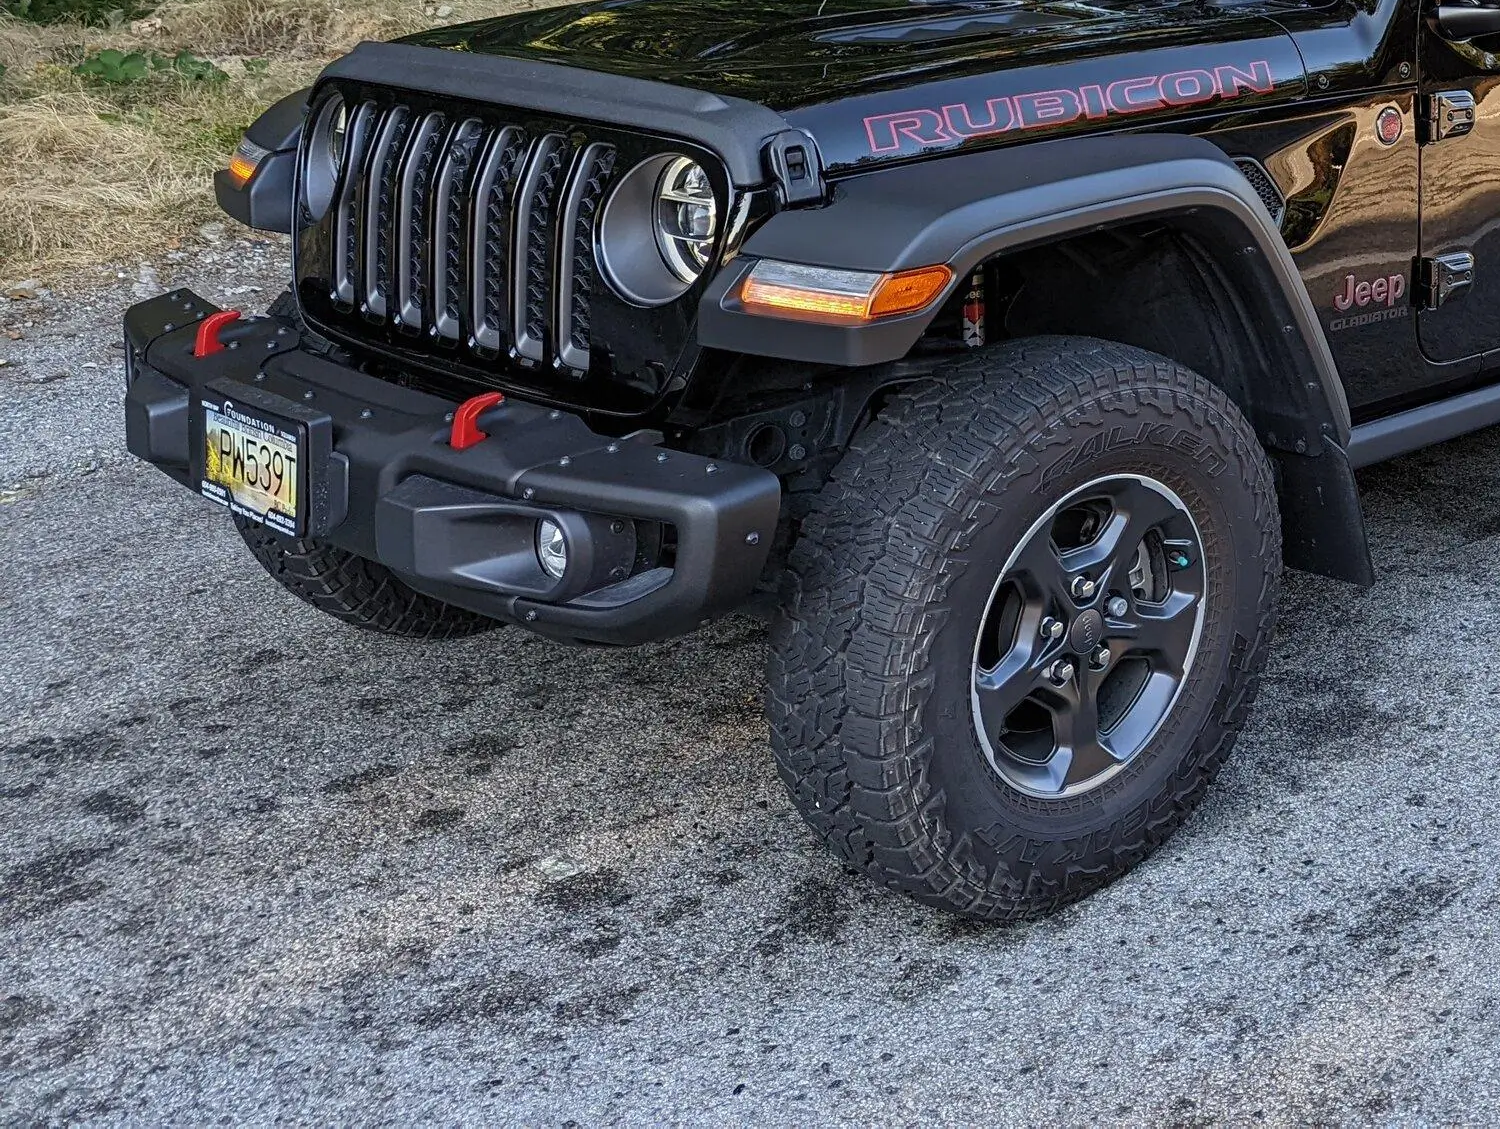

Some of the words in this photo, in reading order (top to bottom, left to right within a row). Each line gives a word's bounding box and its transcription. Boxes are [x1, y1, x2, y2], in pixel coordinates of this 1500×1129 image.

[862, 60, 1274, 153] RUBICON
[1333, 274, 1405, 311] Jeep
[1330, 307, 1408, 331] GLADIATOR
[223, 400, 275, 433] FOUNDATION
[220, 428, 296, 504] PW539T
